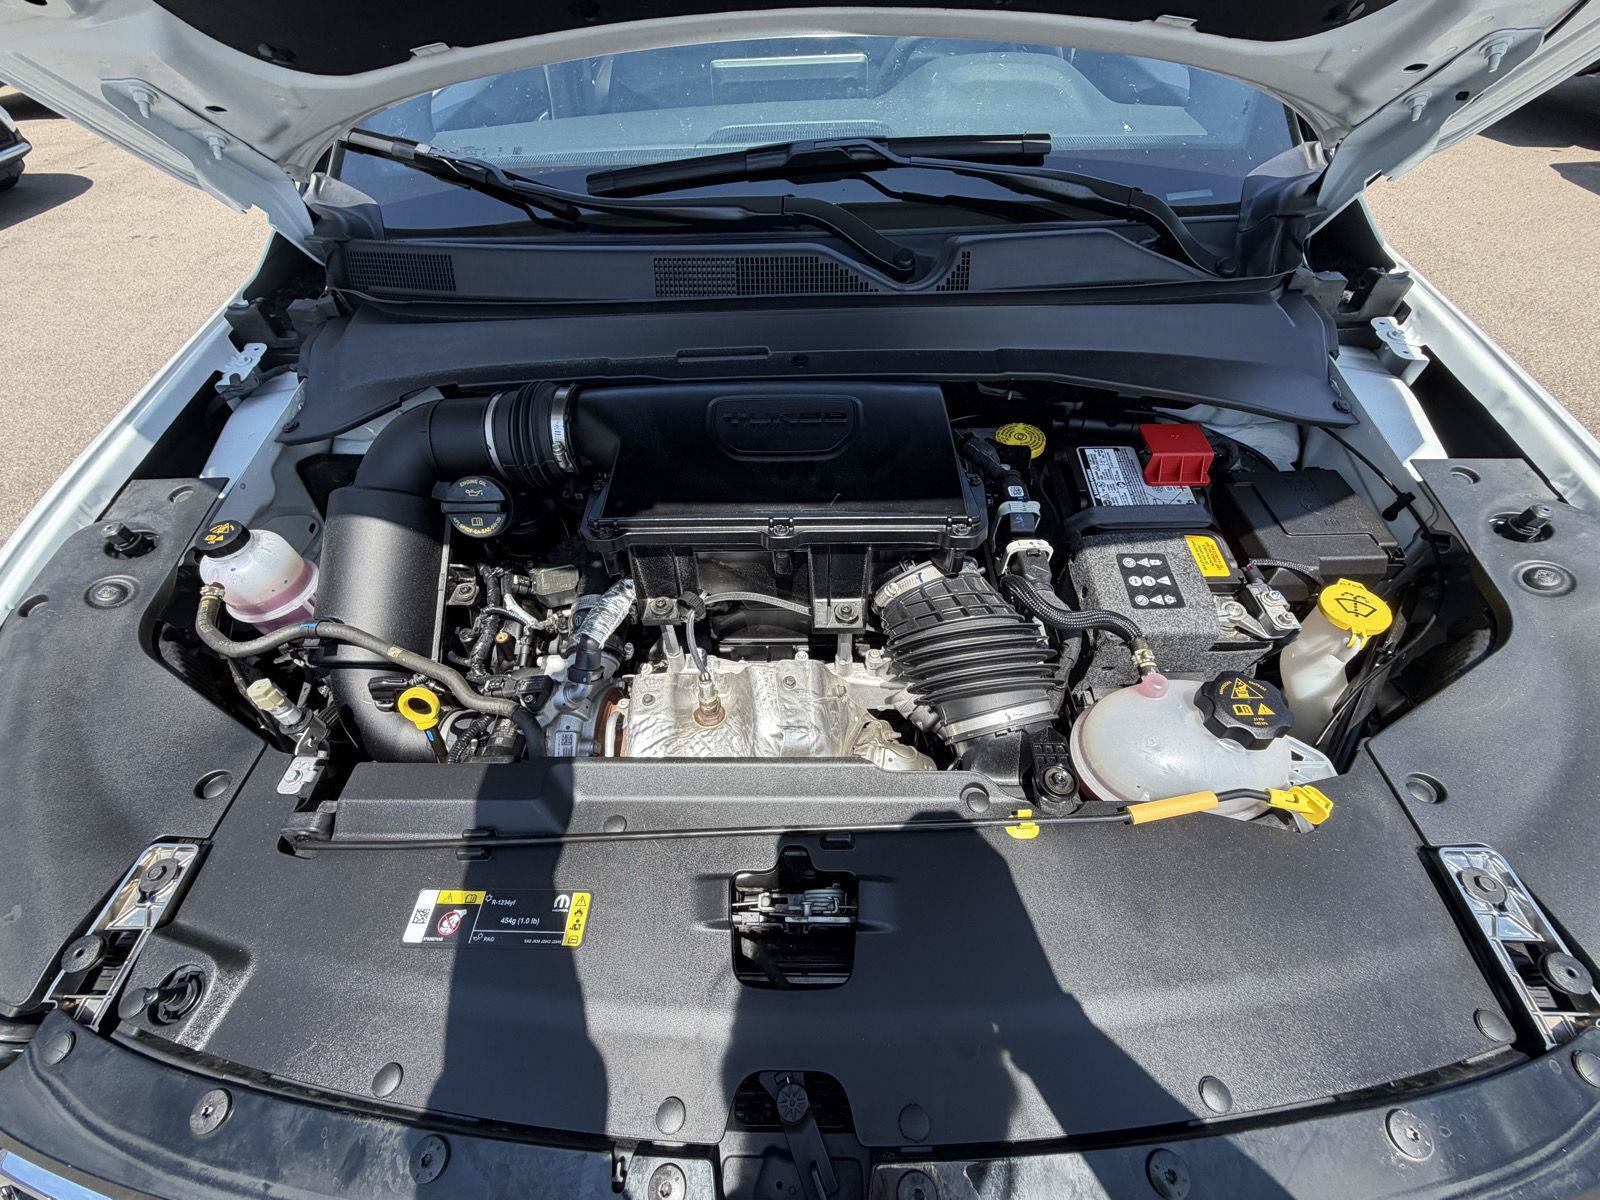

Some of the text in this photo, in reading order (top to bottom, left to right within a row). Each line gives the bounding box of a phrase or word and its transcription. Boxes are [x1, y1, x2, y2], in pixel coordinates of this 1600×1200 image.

[459, 479, 478, 487] ENGINE
[500, 917, 516, 925] 454g
[517, 917, 529, 925] (1.0
